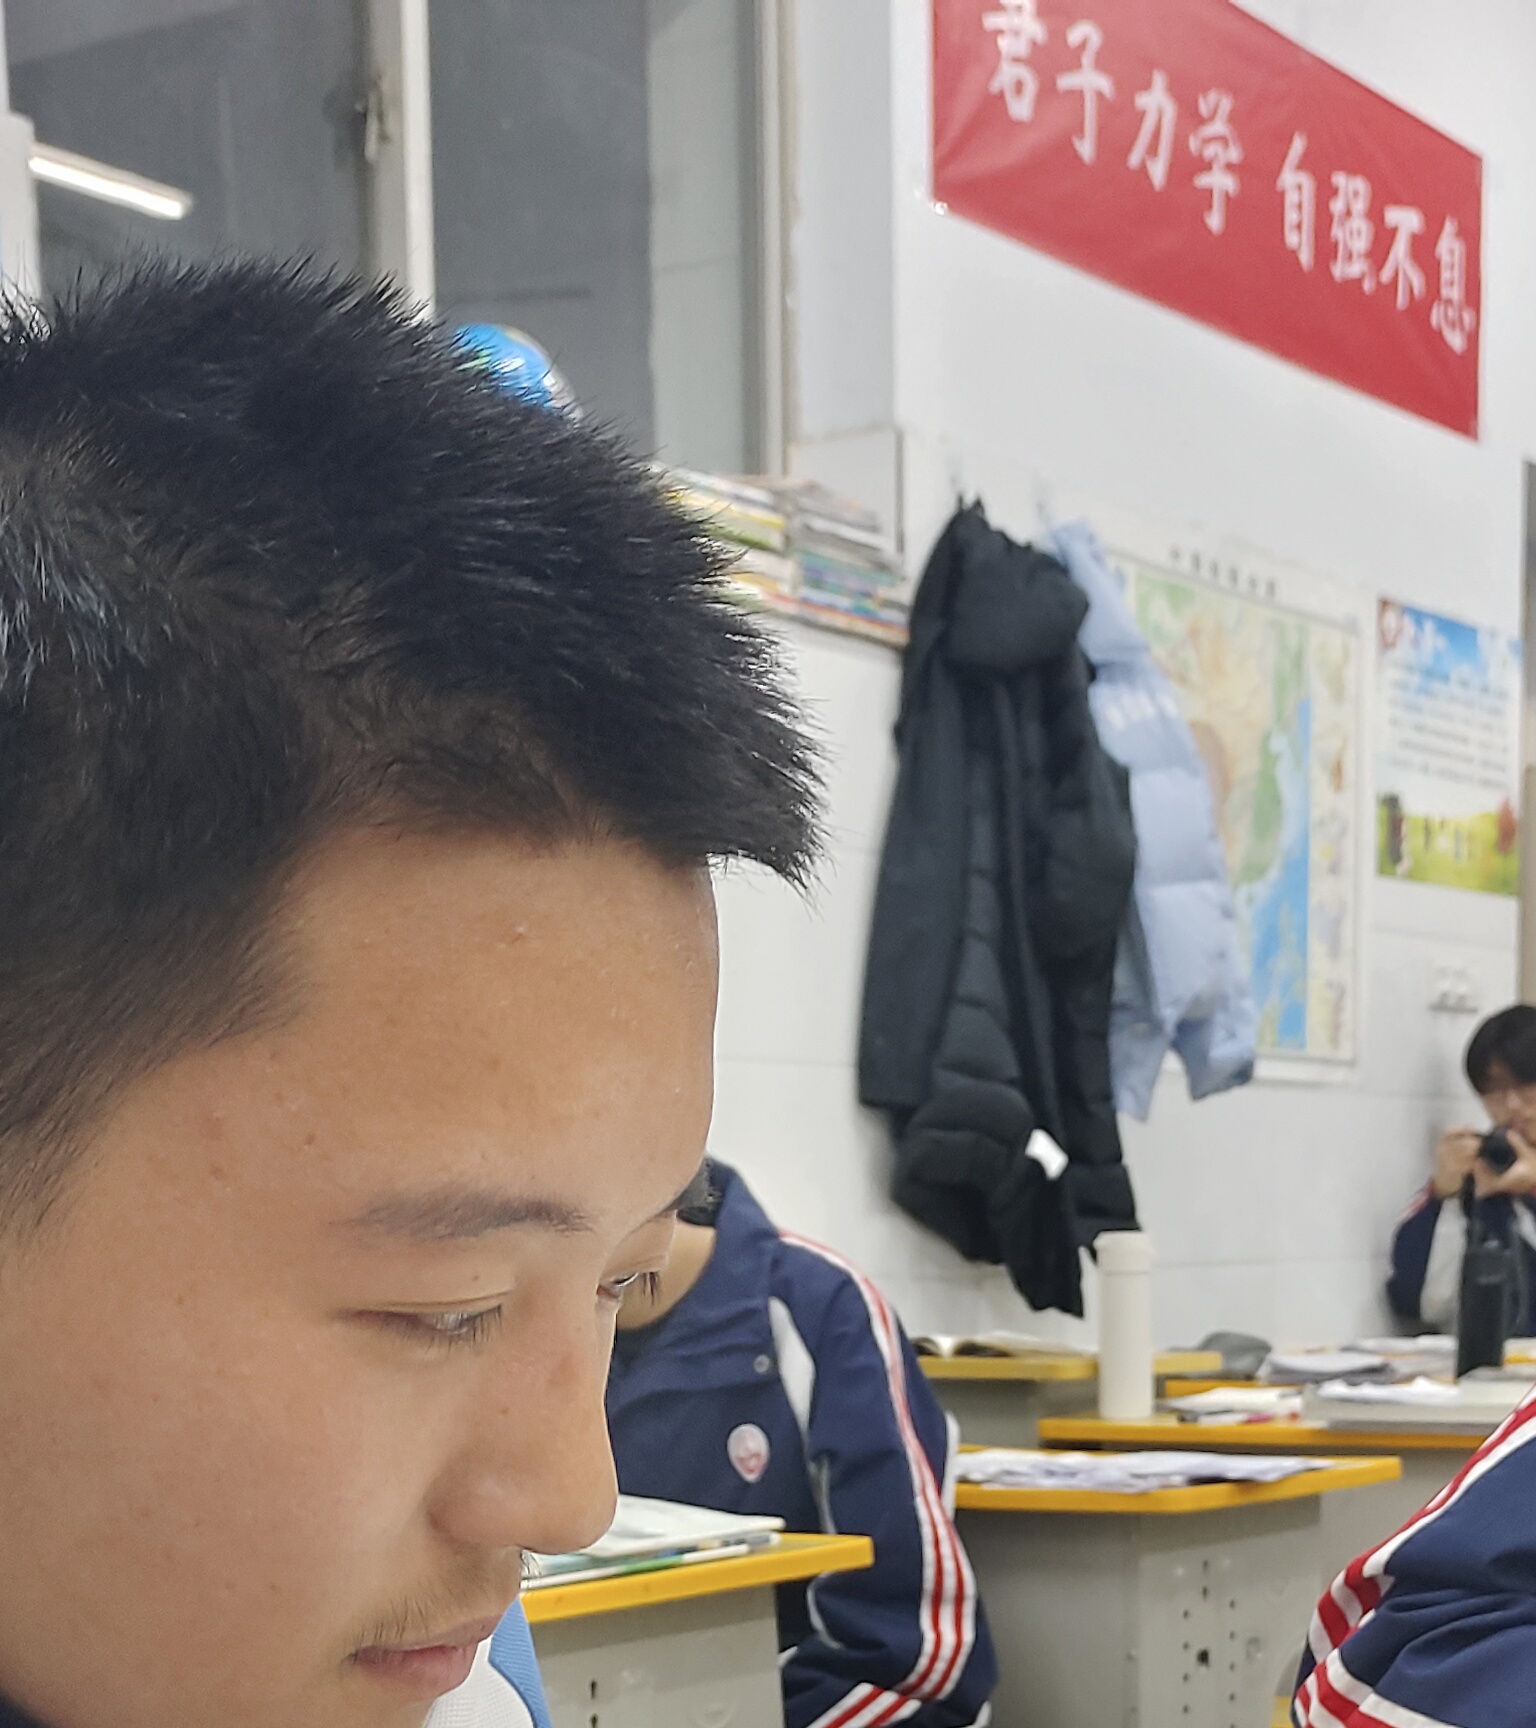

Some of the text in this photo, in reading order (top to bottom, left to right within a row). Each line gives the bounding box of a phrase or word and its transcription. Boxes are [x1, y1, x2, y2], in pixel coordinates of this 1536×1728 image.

[981, 0, 1477, 357] 君子力学 自强不息
